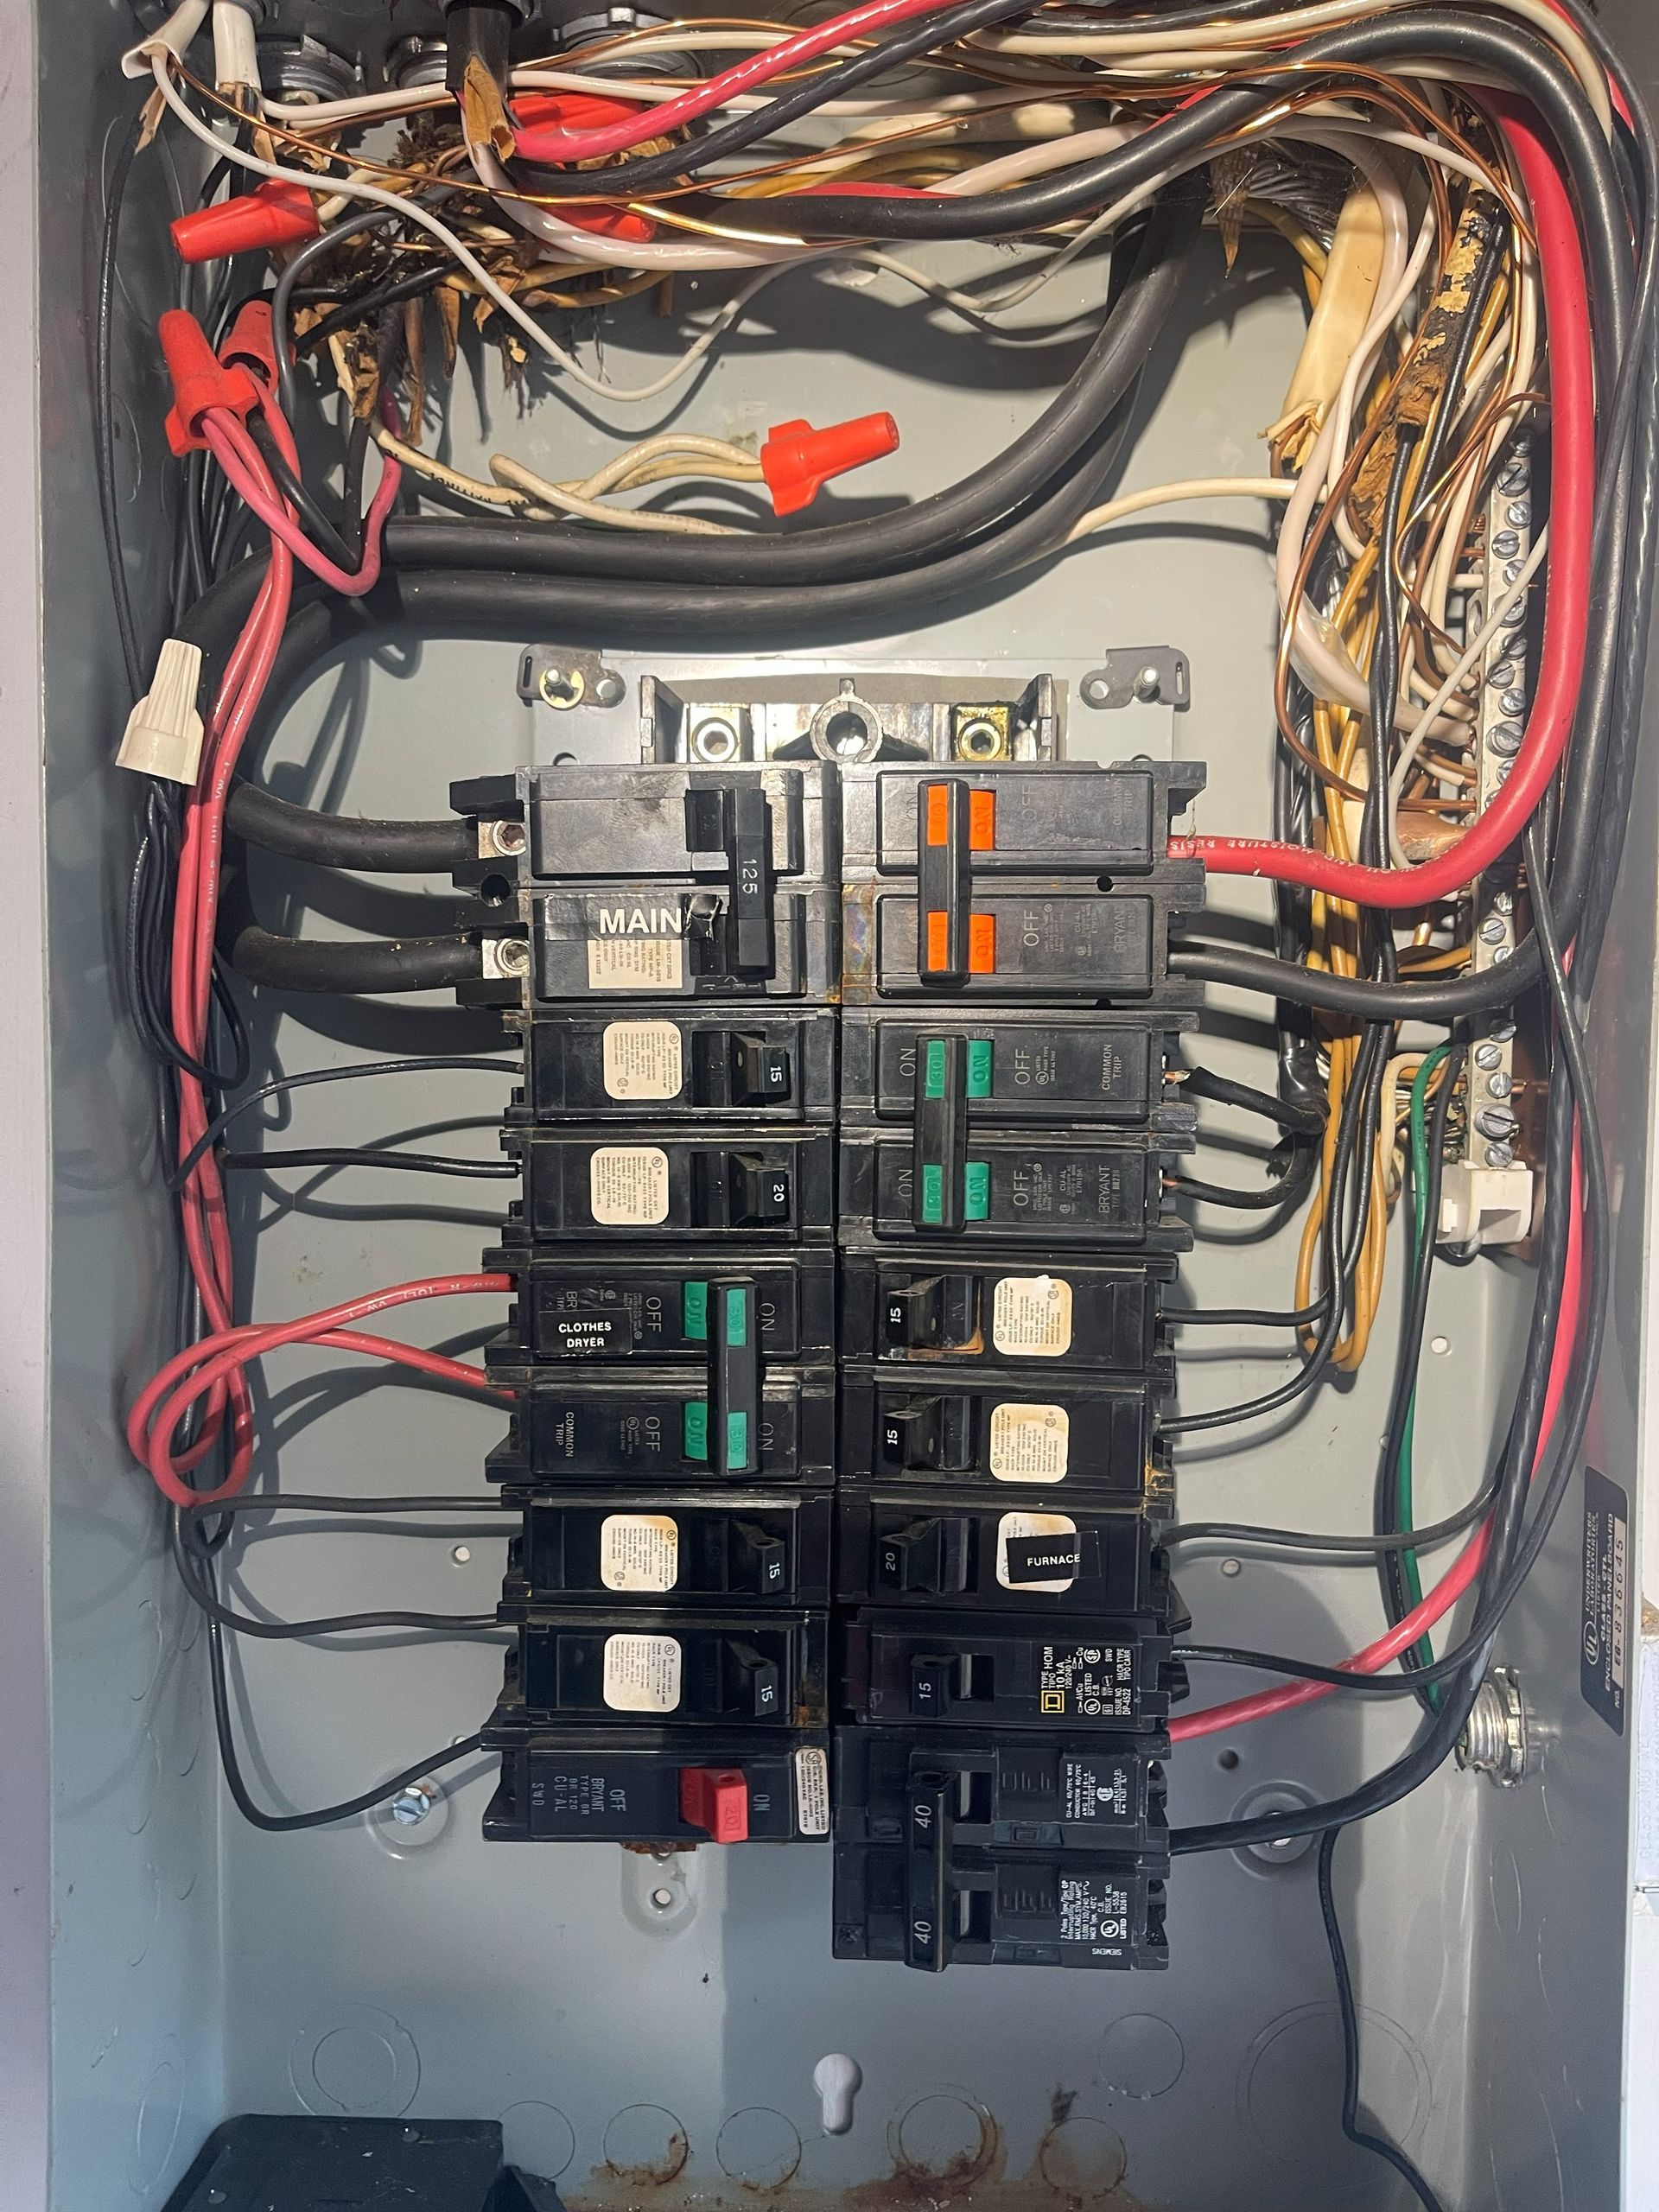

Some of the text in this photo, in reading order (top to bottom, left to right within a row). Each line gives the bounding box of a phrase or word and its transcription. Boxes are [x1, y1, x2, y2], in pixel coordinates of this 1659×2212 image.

[975, 807, 988, 835] ON
[742, 859, 758, 895] 125
[600, 908, 682, 934] MAIN
[1023, 910, 1039, 946] OFF
[976, 930, 988, 957] ON
[770, 1065, 782, 1083] 15
[899, 1048, 915, 1076] ON
[931, 1059, 942, 1079] 30
[972, 1055, 987, 1083] ON
[1014, 1049, 1030, 1084] OFF
[1102, 1044, 1112, 1090] COMMON
[1113, 1056, 1122, 1079] TRIP
[773, 1184, 785, 1202] 20
[899, 1169, 912, 1197] ON
[969, 1177, 985, 1205] ON
[1013, 1170, 1029, 1206] OFF
[1098, 1165, 1110, 1213] BRYANT
[645, 1297, 662, 1333] OFF
[690, 1298, 702, 1325] ON
[760, 1303, 775, 1331] ON
[890, 1307, 901, 1323] 15
[558, 1321, 612, 1334] CLOTHES
[566, 1337, 605, 1349] DRYER
[556, 1422, 564, 1446] TRIP
[565, 1412, 575, 1457] COMMON
[645, 1416, 660, 1452] OFF
[690, 1417, 703, 1446] ON
[758, 1422, 773, 1450] ON
[887, 1429, 898, 1446] 15
[768, 1562, 780, 1579] 15
[885, 1552, 896, 1571] 20
[1027, 1554, 1081, 1567] FURNACE
[1044, 1646, 1053, 1669] HOM
[1076, 1647, 1084, 1656] Cu
[1056, 1662, 1065, 1689] 10 kA
[761, 1685, 772, 1701] 15
[918, 1682, 931, 1700] 15
[532, 1783, 544, 1806] SWD
[554, 1776, 568, 1812] CU-AL
[569, 1778, 578, 1810] BR 120
[580, 1775, 589, 1815] TYPE BR
[591, 1778, 605, 1812] BRYANT
[609, 1789, 626, 1811] OFF
[753, 1794, 771, 1811] ON
[915, 1804, 931, 1828] 40
[914, 1920, 931, 1944] 40
[1091, 1948, 1122, 1956] SIEMENS
